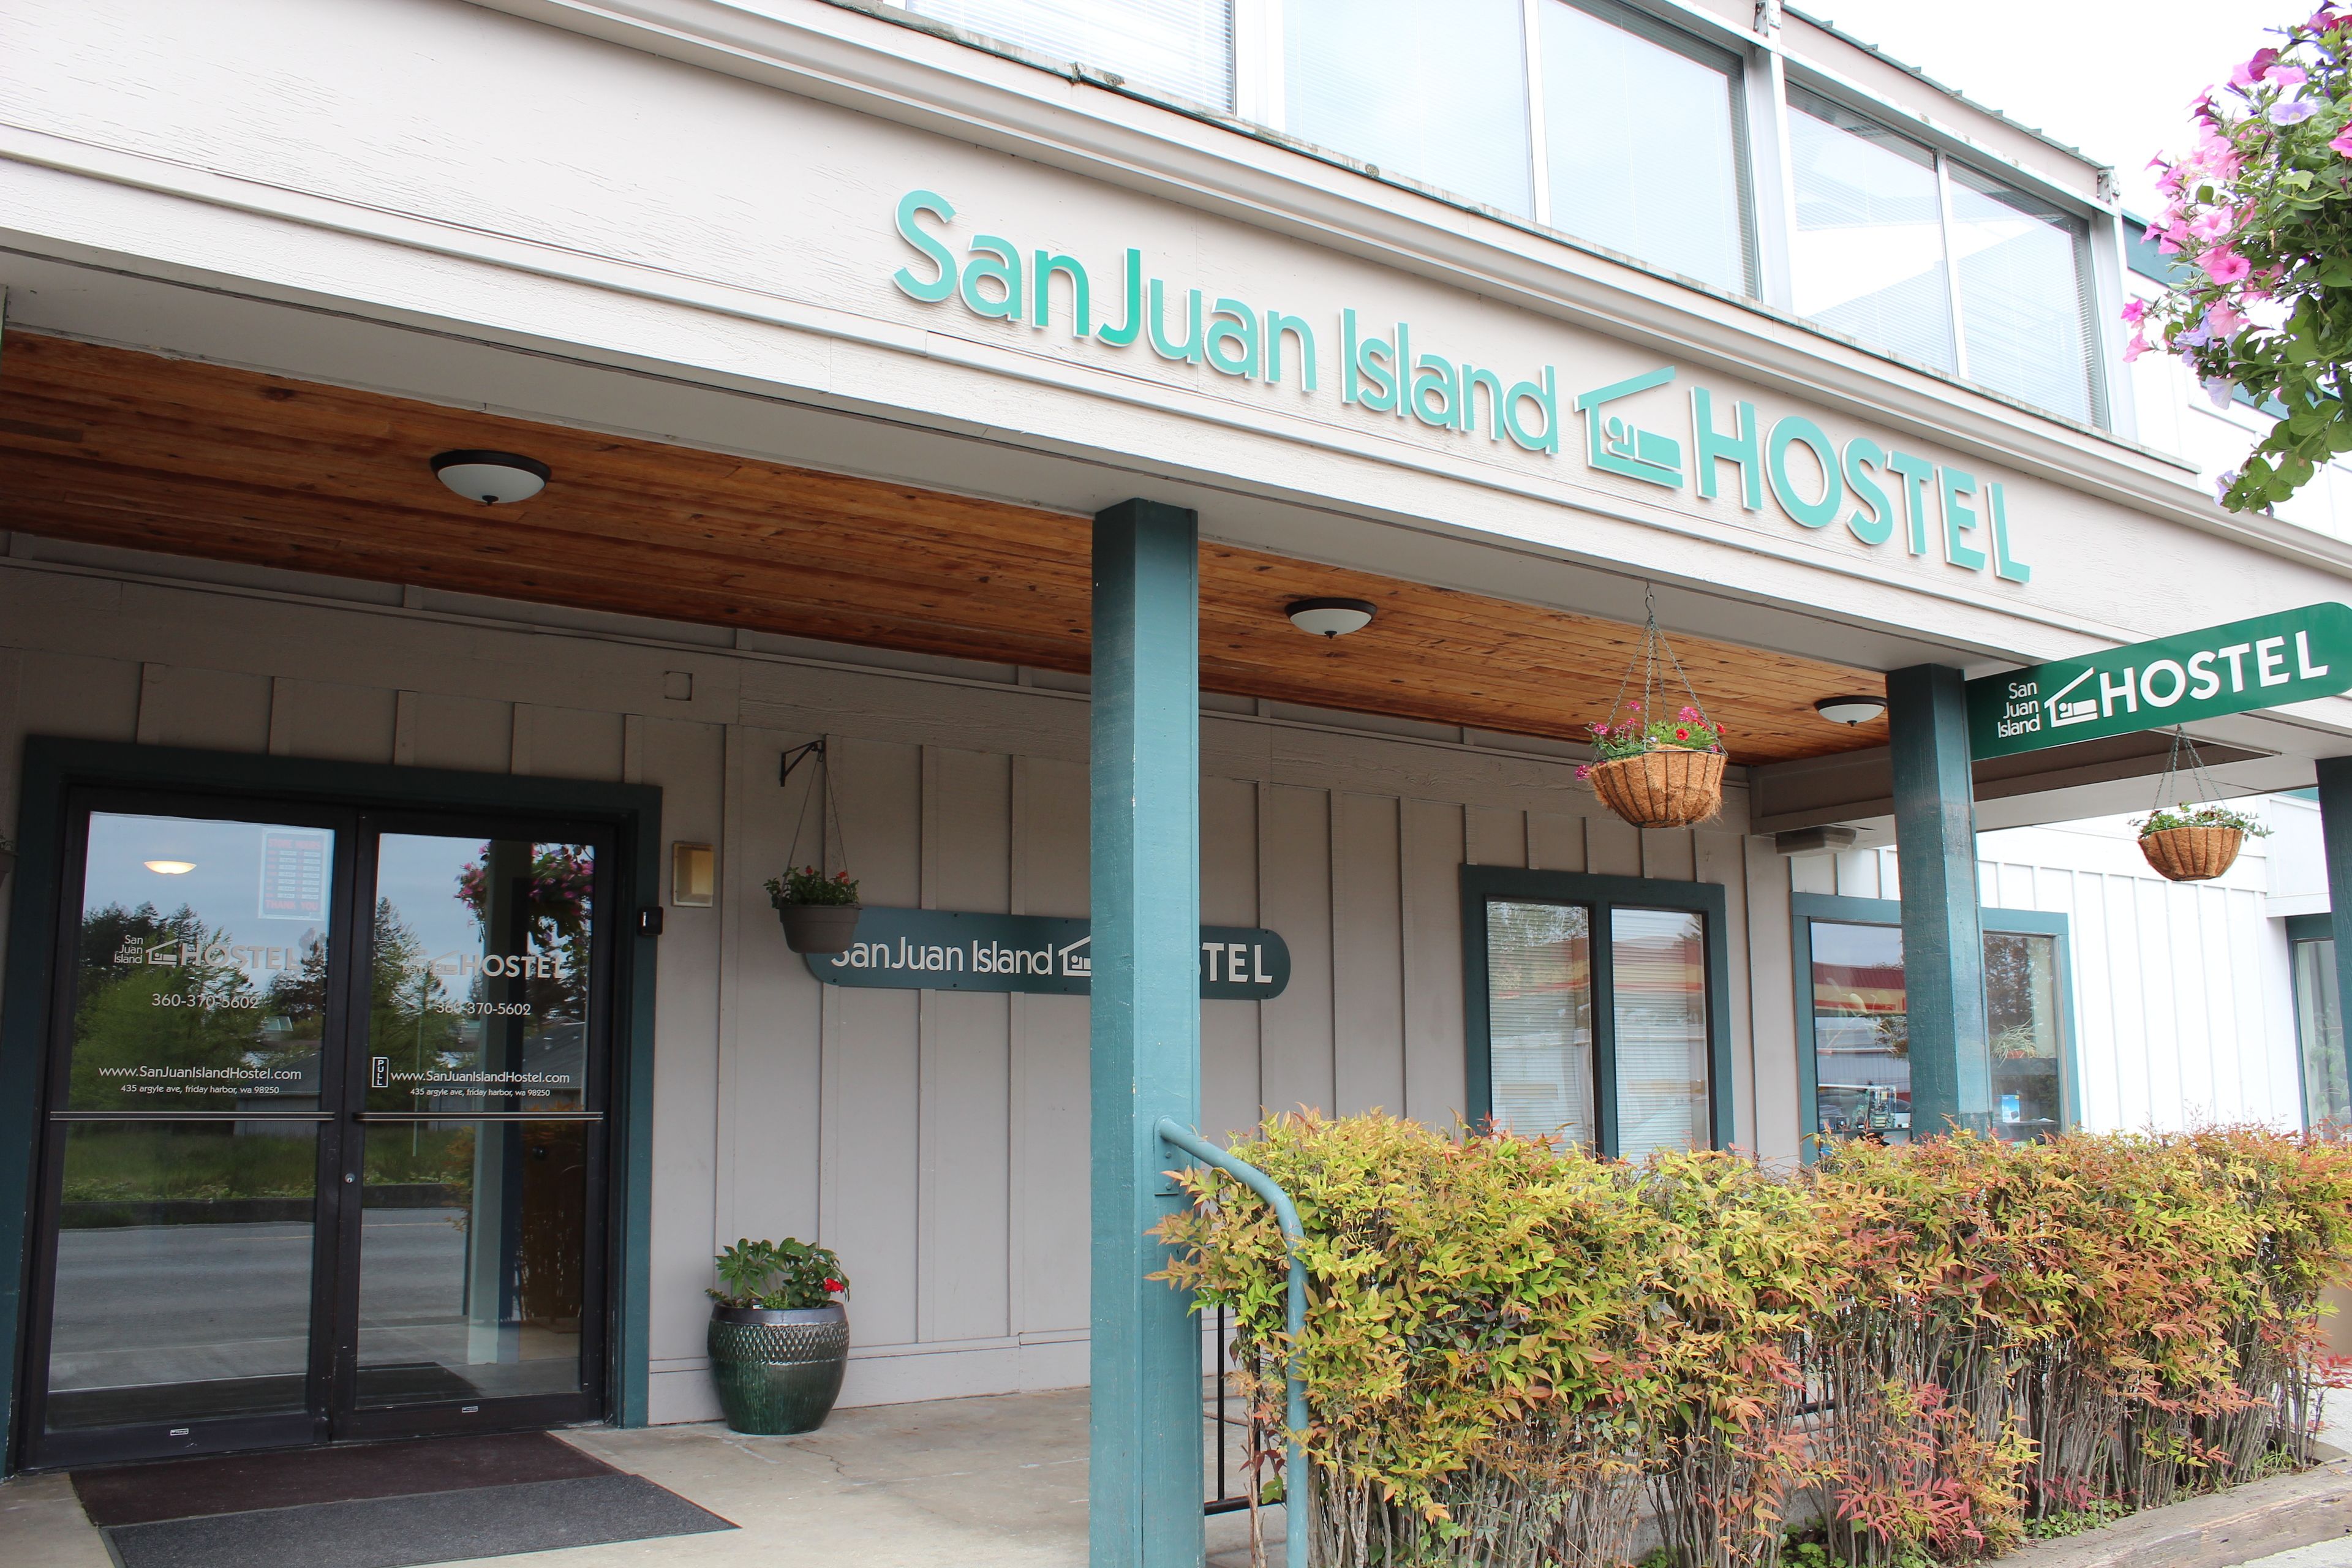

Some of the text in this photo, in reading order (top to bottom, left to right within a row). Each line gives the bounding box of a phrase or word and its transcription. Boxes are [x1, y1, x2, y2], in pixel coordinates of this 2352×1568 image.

[1340, 307, 1559, 455] Island
[1691, 386, 2030, 583] HOSTEL
[2099, 630, 2328, 718] HOSTEL
[2008, 680, 2037, 700] San
[2003, 699, 2039, 720] Juan
[1997, 714, 2041, 738] Island
[124, 935, 143, 944] San
[118, 944, 143, 954] Juan
[180, 943, 303, 971] HOSTEL
[114, 953, 143, 964] Island
[460, 953, 564, 979] HOSTEL
[973, 940, 1053, 975] Island
[1200, 942, 1273, 983] TEL
[152, 993, 258, 1009] 360-370-5602
[436, 1002, 531, 1016] 360-370-5602
[99, 1065, 302, 1080] www.SanJuanIslandHostel.com
[391, 1071, 570, 1084] www.SanJuanIslandHostel.com
[139, 1085, 164, 1094] argyle
[185, 1085, 208, 1094] friday
[210, 1085, 238, 1095] harbor,
[466, 1088, 487, 1097] friday
[489, 1088, 513, 1097] harbor,
